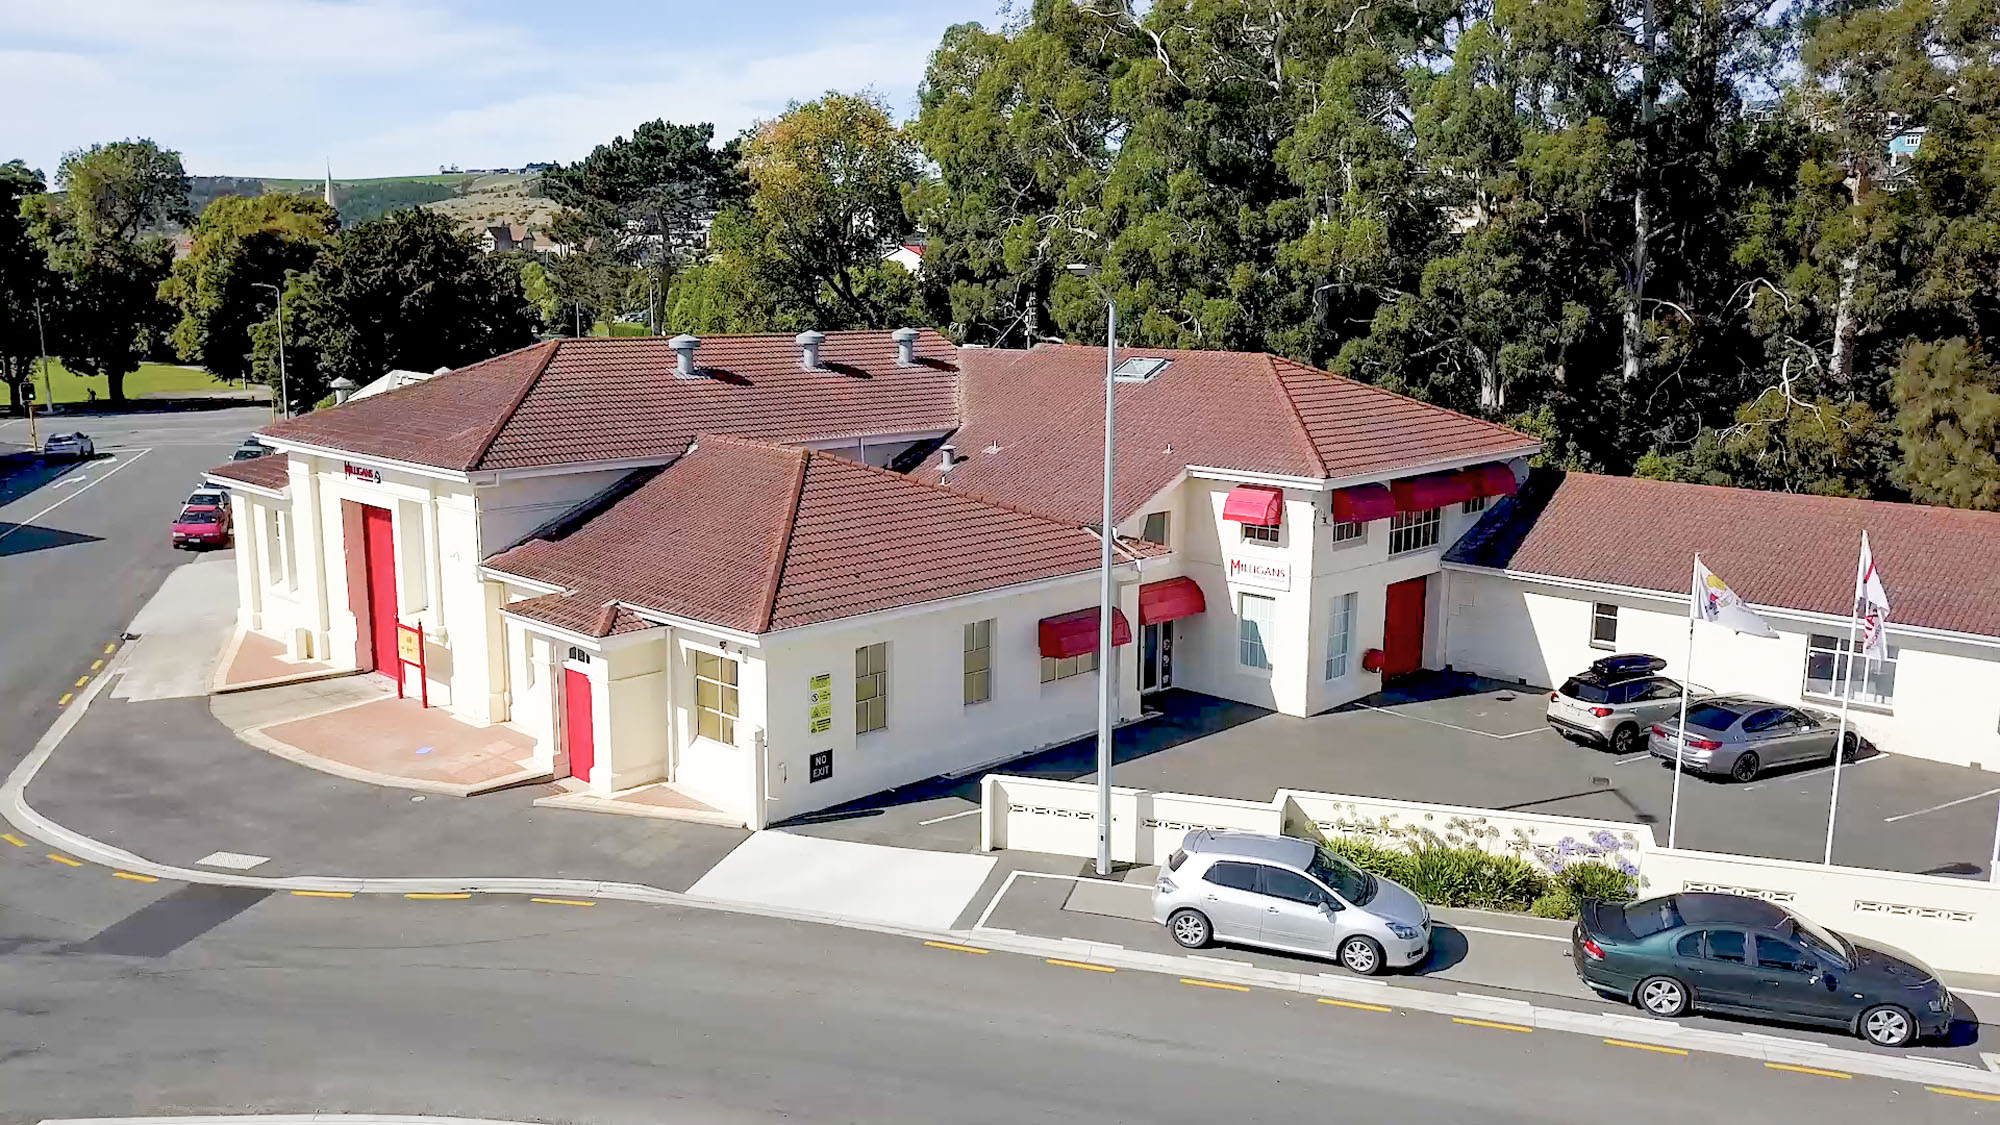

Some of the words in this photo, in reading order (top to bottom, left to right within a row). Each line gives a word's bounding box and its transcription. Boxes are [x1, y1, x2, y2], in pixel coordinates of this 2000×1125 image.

[1230, 558, 1286, 578] MILLIGANS
[815, 755, 827, 766] NO
[813, 765, 830, 778] EXIT
